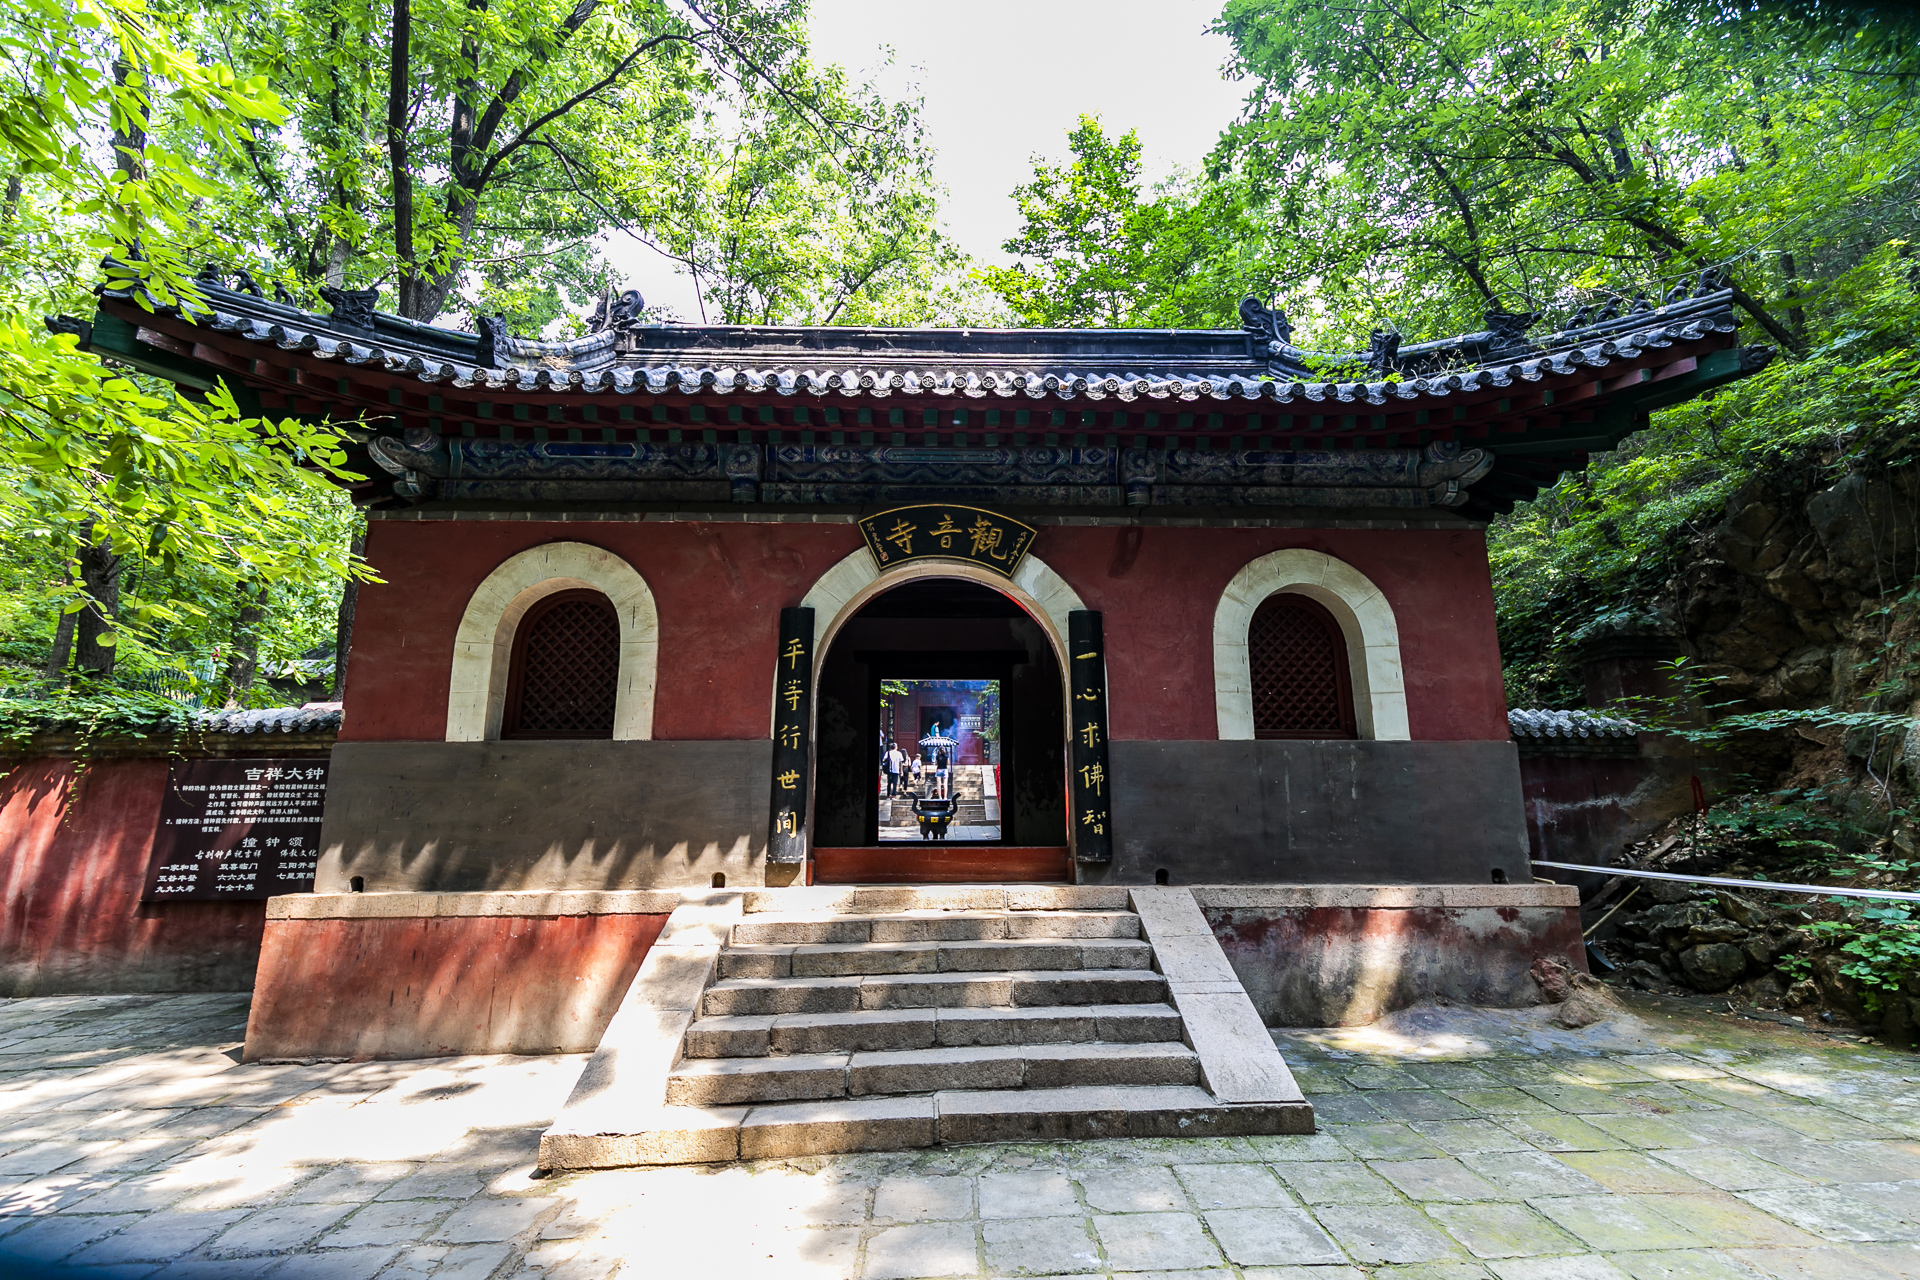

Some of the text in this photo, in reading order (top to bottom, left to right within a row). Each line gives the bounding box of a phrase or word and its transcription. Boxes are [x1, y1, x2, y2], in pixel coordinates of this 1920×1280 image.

[1076, 651, 1106, 835] 一心求佛智
[244, 767, 324, 781] 吉祥大钟
[242, 837, 304, 848] 撞钟颂
[280, 848, 318, 858] 佛教文化
[159, 863, 199, 871] 一家和睦
[157, 874, 198, 882] 五谷丰登
[217, 873, 257, 881] 六六大顺
[154, 883, 255, 893] 九九大寿 十全十美
